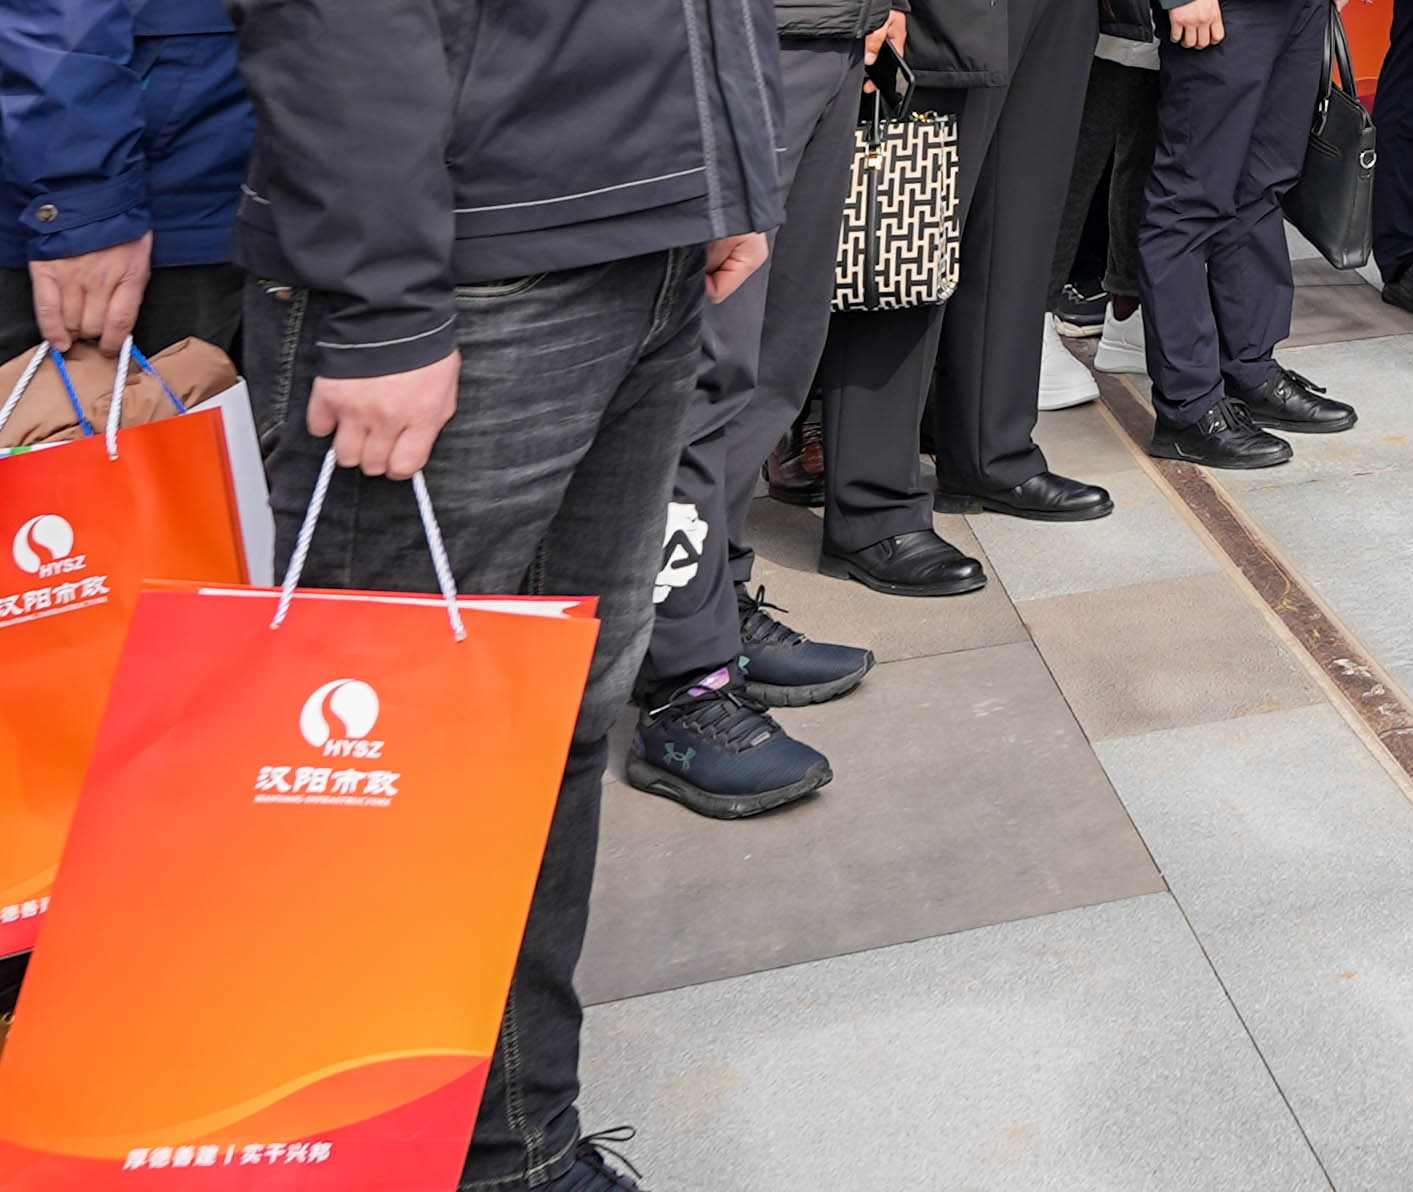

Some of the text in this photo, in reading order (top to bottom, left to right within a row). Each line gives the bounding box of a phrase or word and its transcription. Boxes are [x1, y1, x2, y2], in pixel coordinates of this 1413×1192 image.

[39, 553, 88, 579] HYSZ
[322, 738, 385, 759] HYSZ
[254, 765, 401, 797] 汉阳市政
